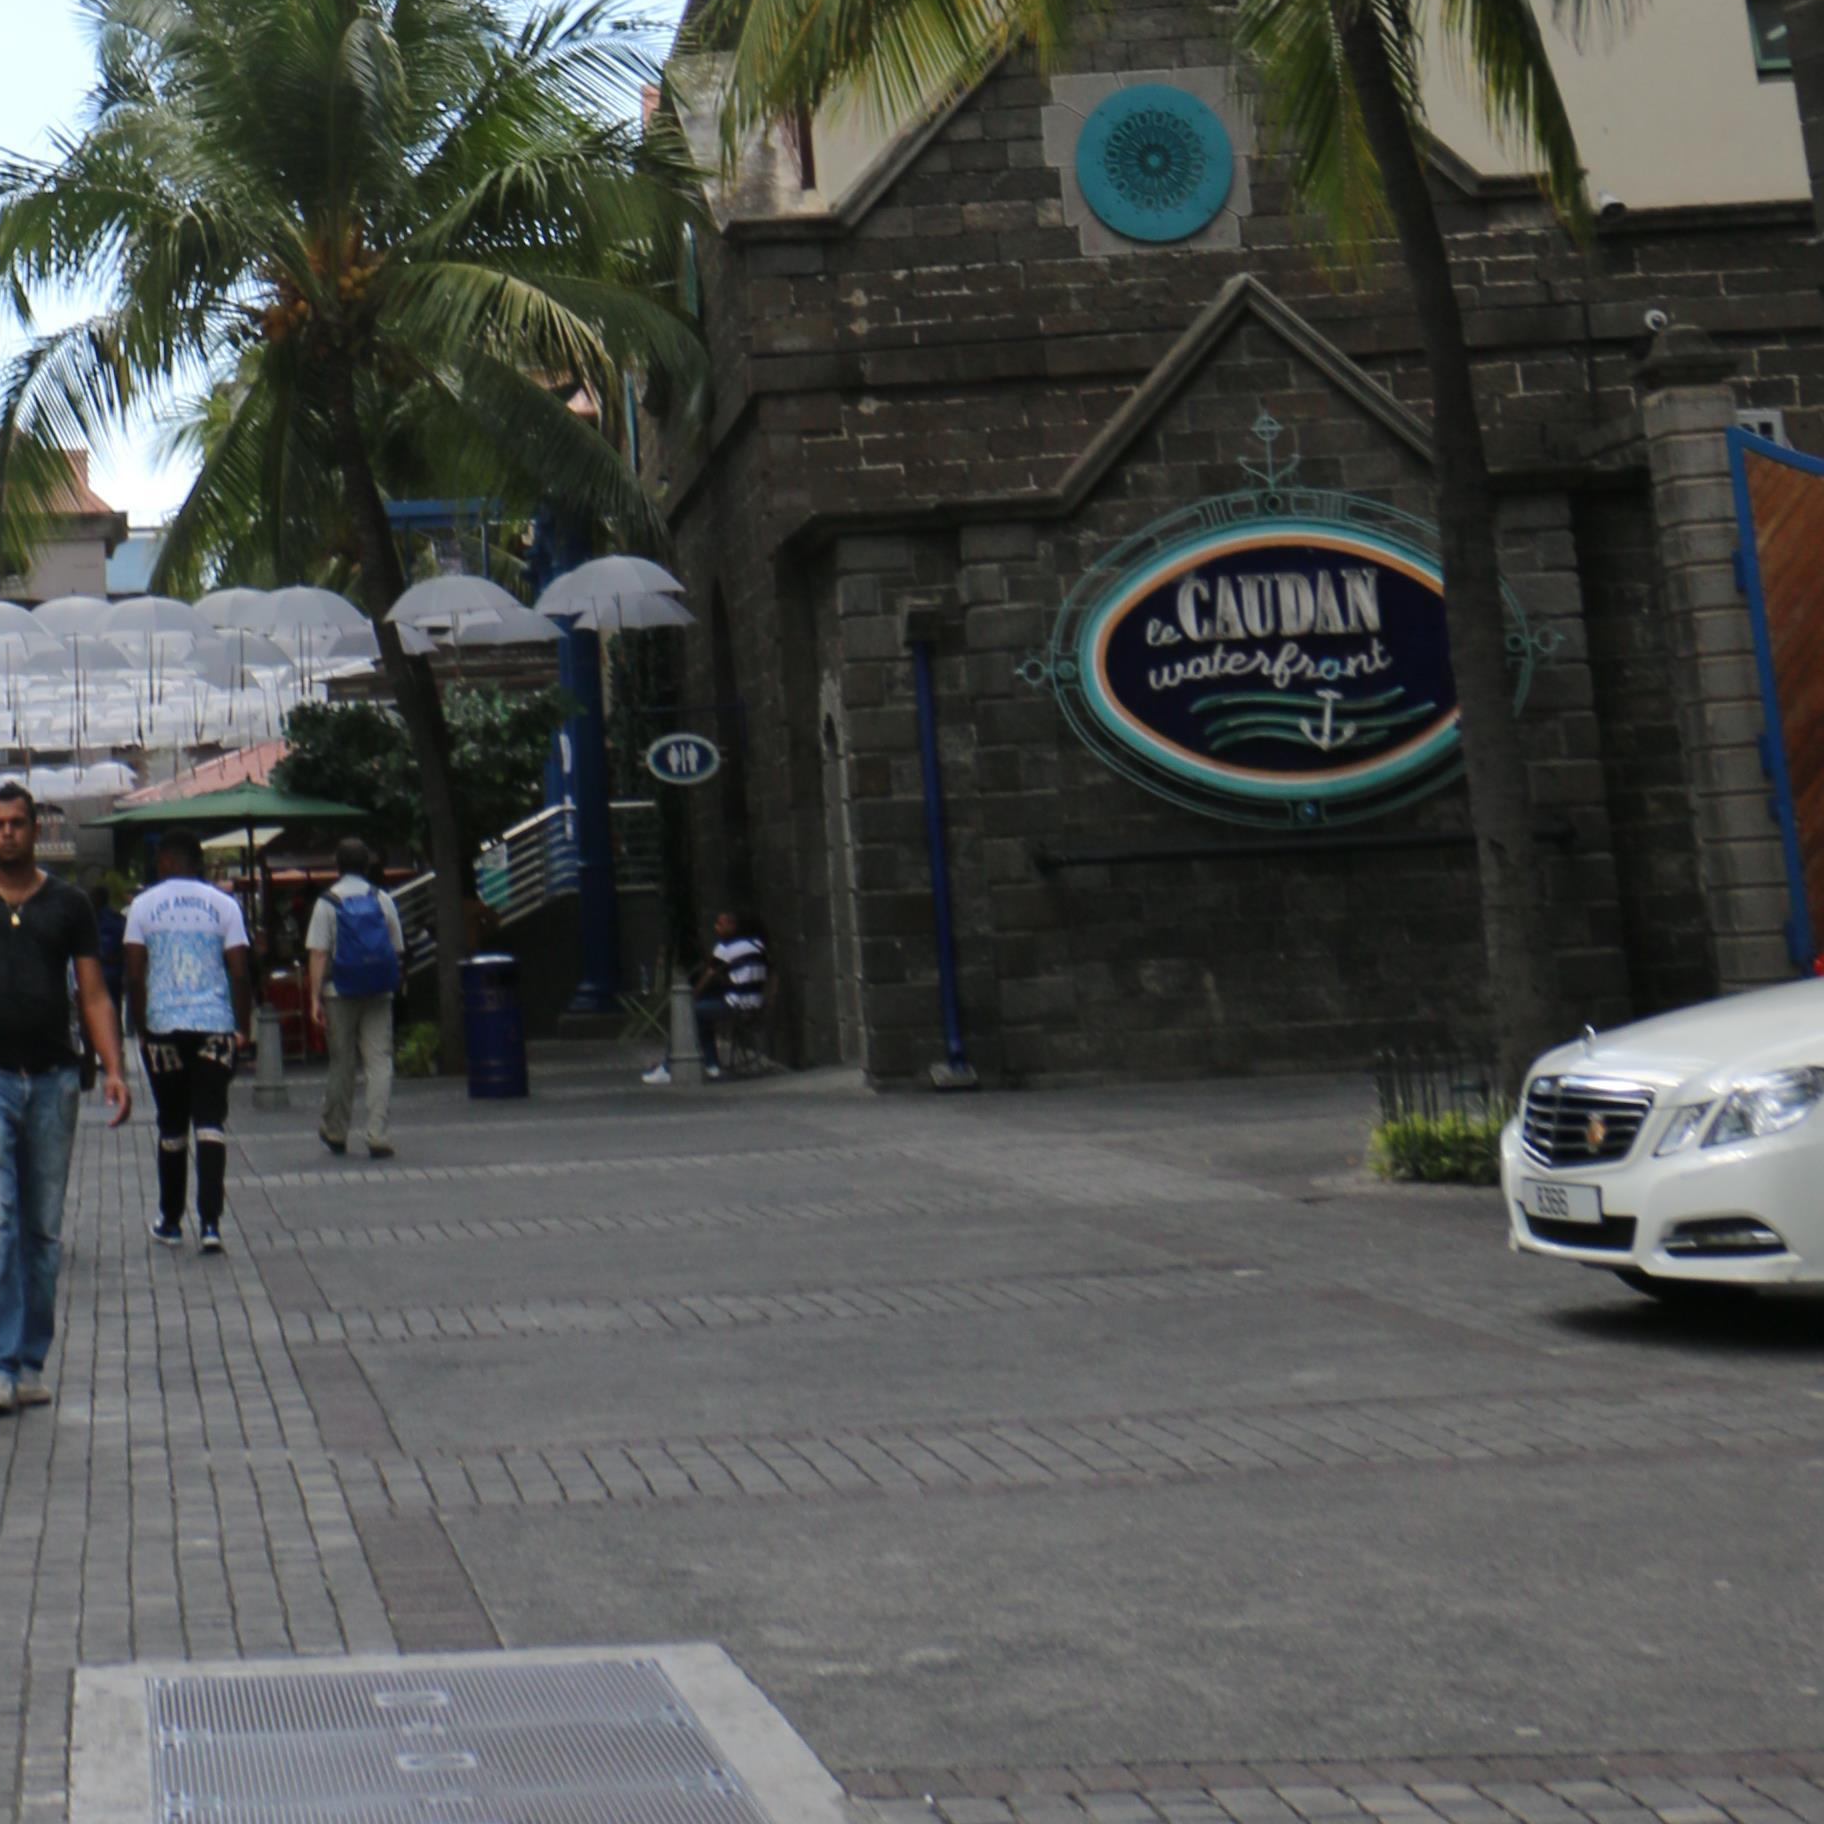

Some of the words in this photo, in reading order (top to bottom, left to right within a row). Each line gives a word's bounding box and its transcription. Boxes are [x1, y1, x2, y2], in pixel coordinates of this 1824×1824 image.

[1146, 617, 1181, 646] le
[1177, 568, 1381, 642] CAUDAN
[1149, 638, 1393, 690] waterfront
[150, 899, 170, 922] LOS
[173, 895, 221, 924] ANGELES
